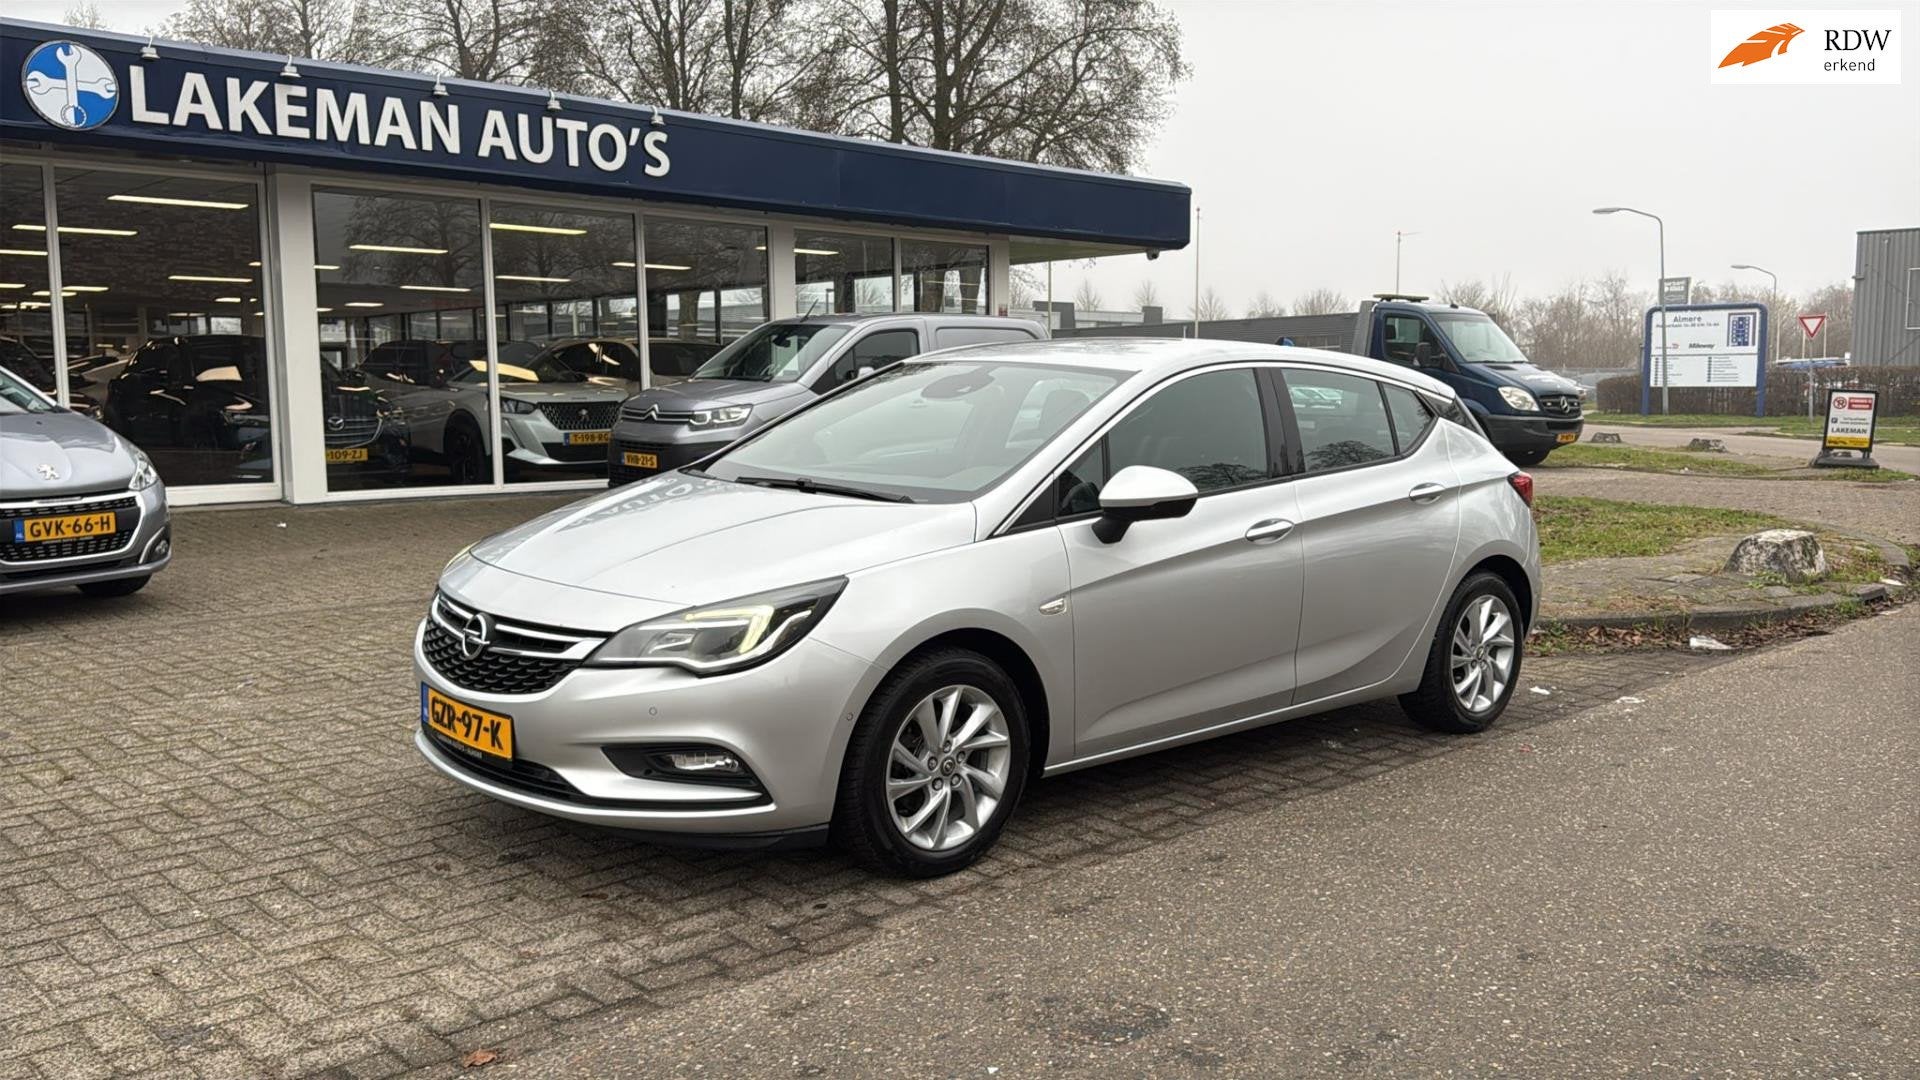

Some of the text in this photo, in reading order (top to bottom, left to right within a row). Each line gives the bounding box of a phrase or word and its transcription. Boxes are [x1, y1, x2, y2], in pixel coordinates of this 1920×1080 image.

[128, 63, 672, 178] LAKEMAN AUTO'S
[1830, 426, 1868, 435] LAKEMAN
[29, 515, 111, 538] GVK-66-H
[431, 695, 504, 751] GZR-97-K
